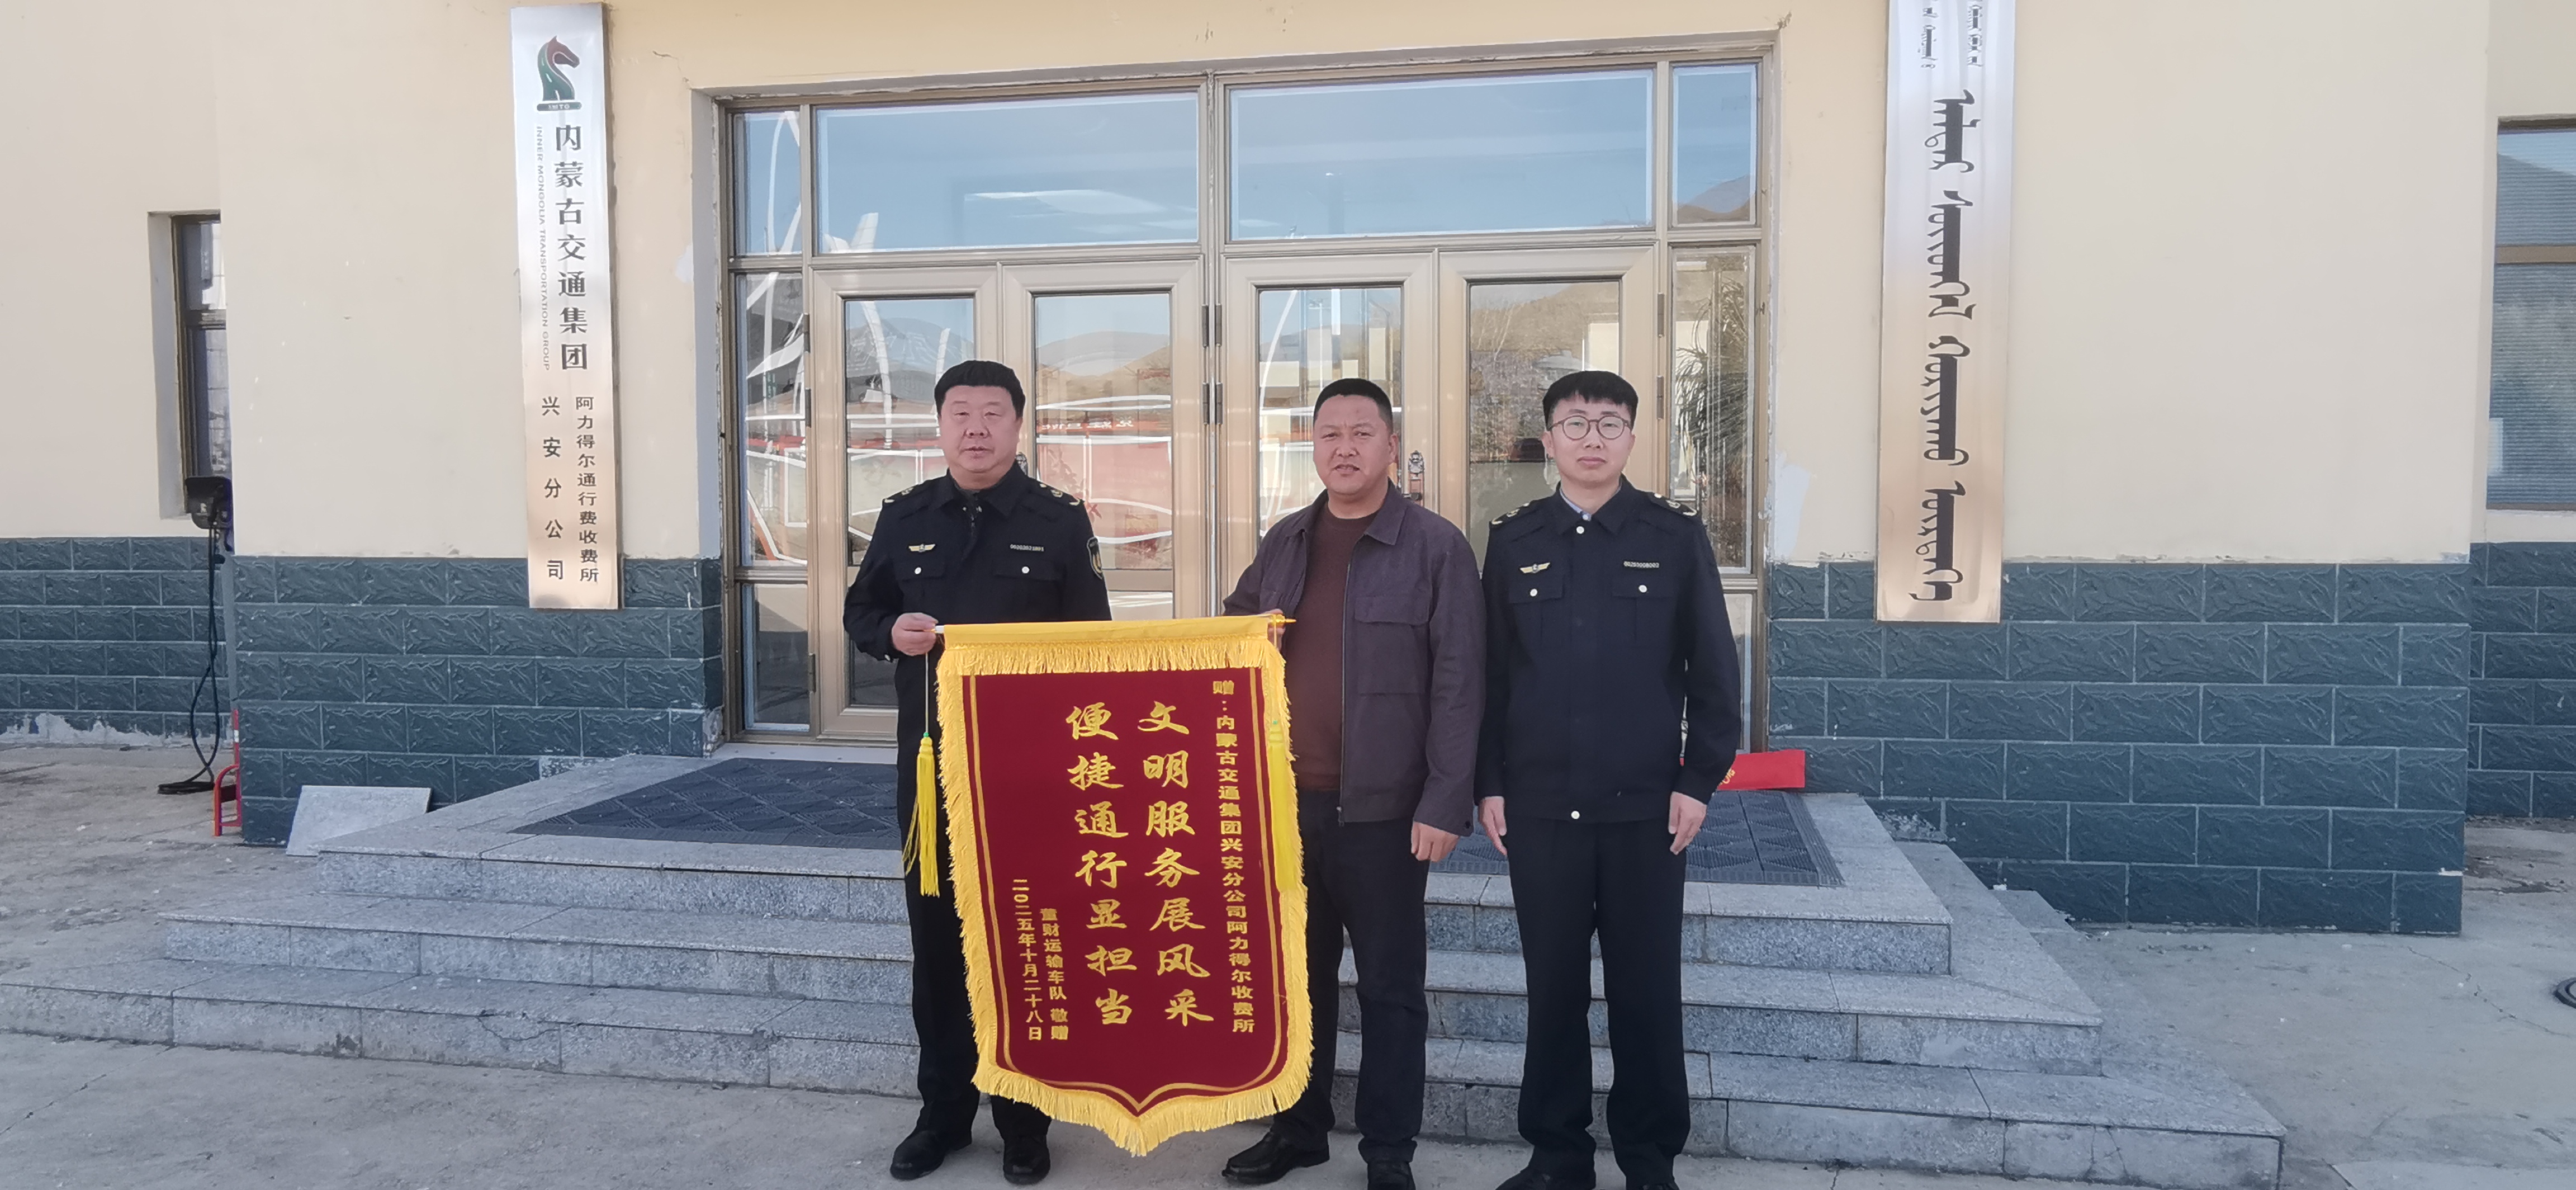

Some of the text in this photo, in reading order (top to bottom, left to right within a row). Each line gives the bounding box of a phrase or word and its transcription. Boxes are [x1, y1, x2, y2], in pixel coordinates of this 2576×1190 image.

[537, 166, 546, 225] MONGOLIA
[539, 229, 548, 327] TRANSPORTATION
[554, 124, 588, 370] 内蒙古交通集团
[542, 331, 551, 371] GROUP
[542, 396, 564, 580] 兴安分公司
[576, 396, 599, 582] 阿力得尔通行费收费所
[1066, 702, 1138, 1026] 便捷通行显担当
[1138, 701, 1215, 1027] 文明服务展风采
